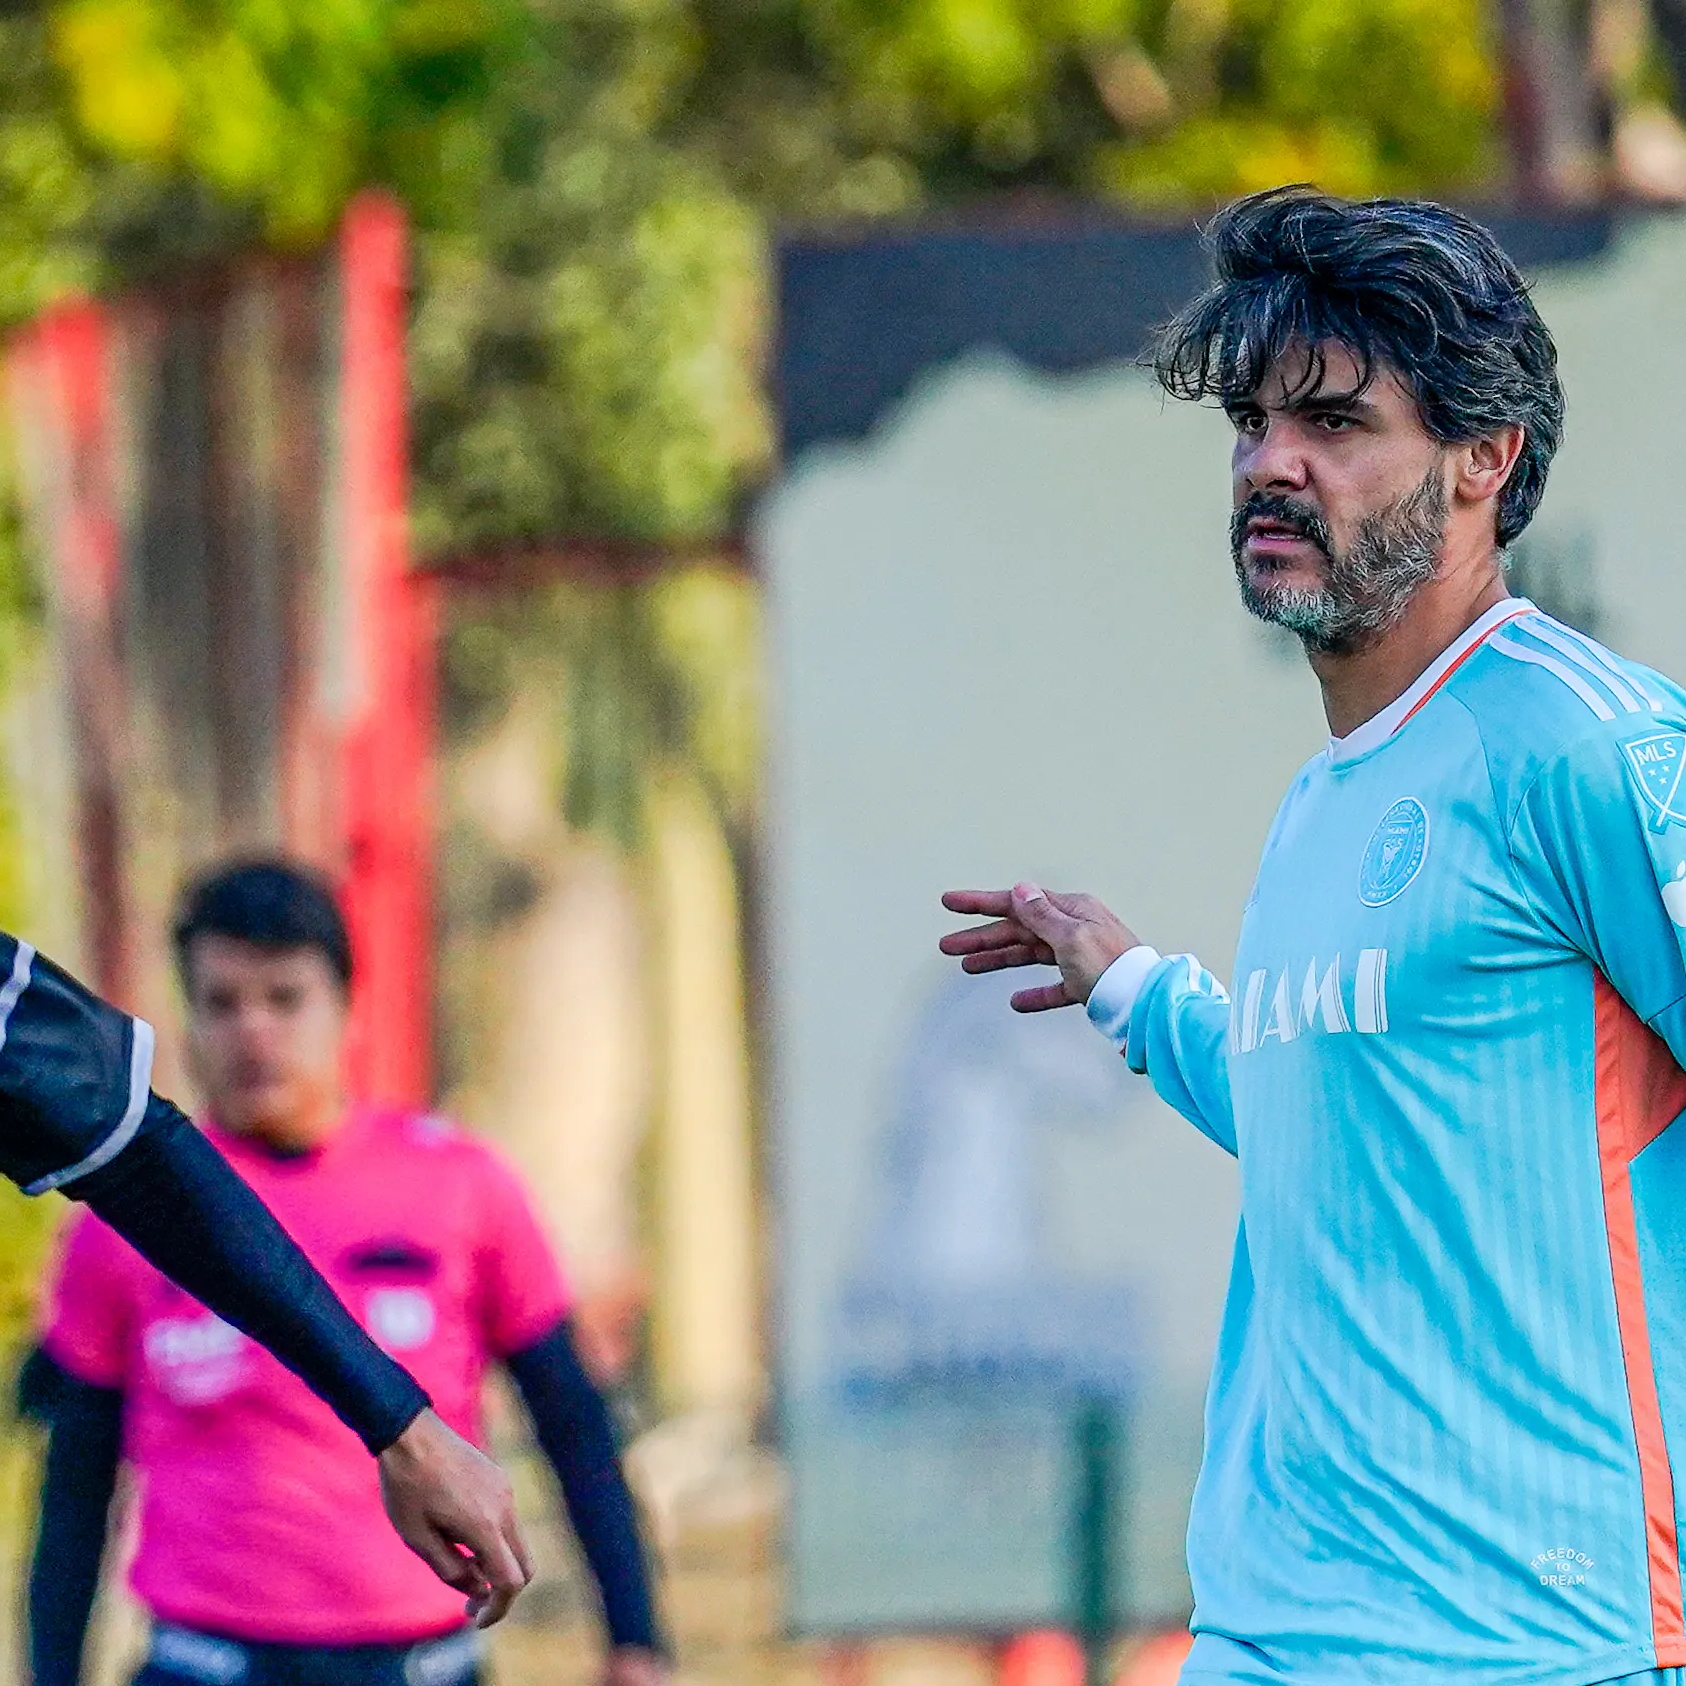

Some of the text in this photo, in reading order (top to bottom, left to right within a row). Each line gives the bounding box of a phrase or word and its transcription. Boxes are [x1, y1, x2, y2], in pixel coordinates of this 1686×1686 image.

[1636, 740, 1677, 765] MLS
[1530, 1547, 1594, 1570] FREEDOM
[1555, 1562, 1570, 1572] TO
[1539, 1574, 1585, 1586] DREAM
